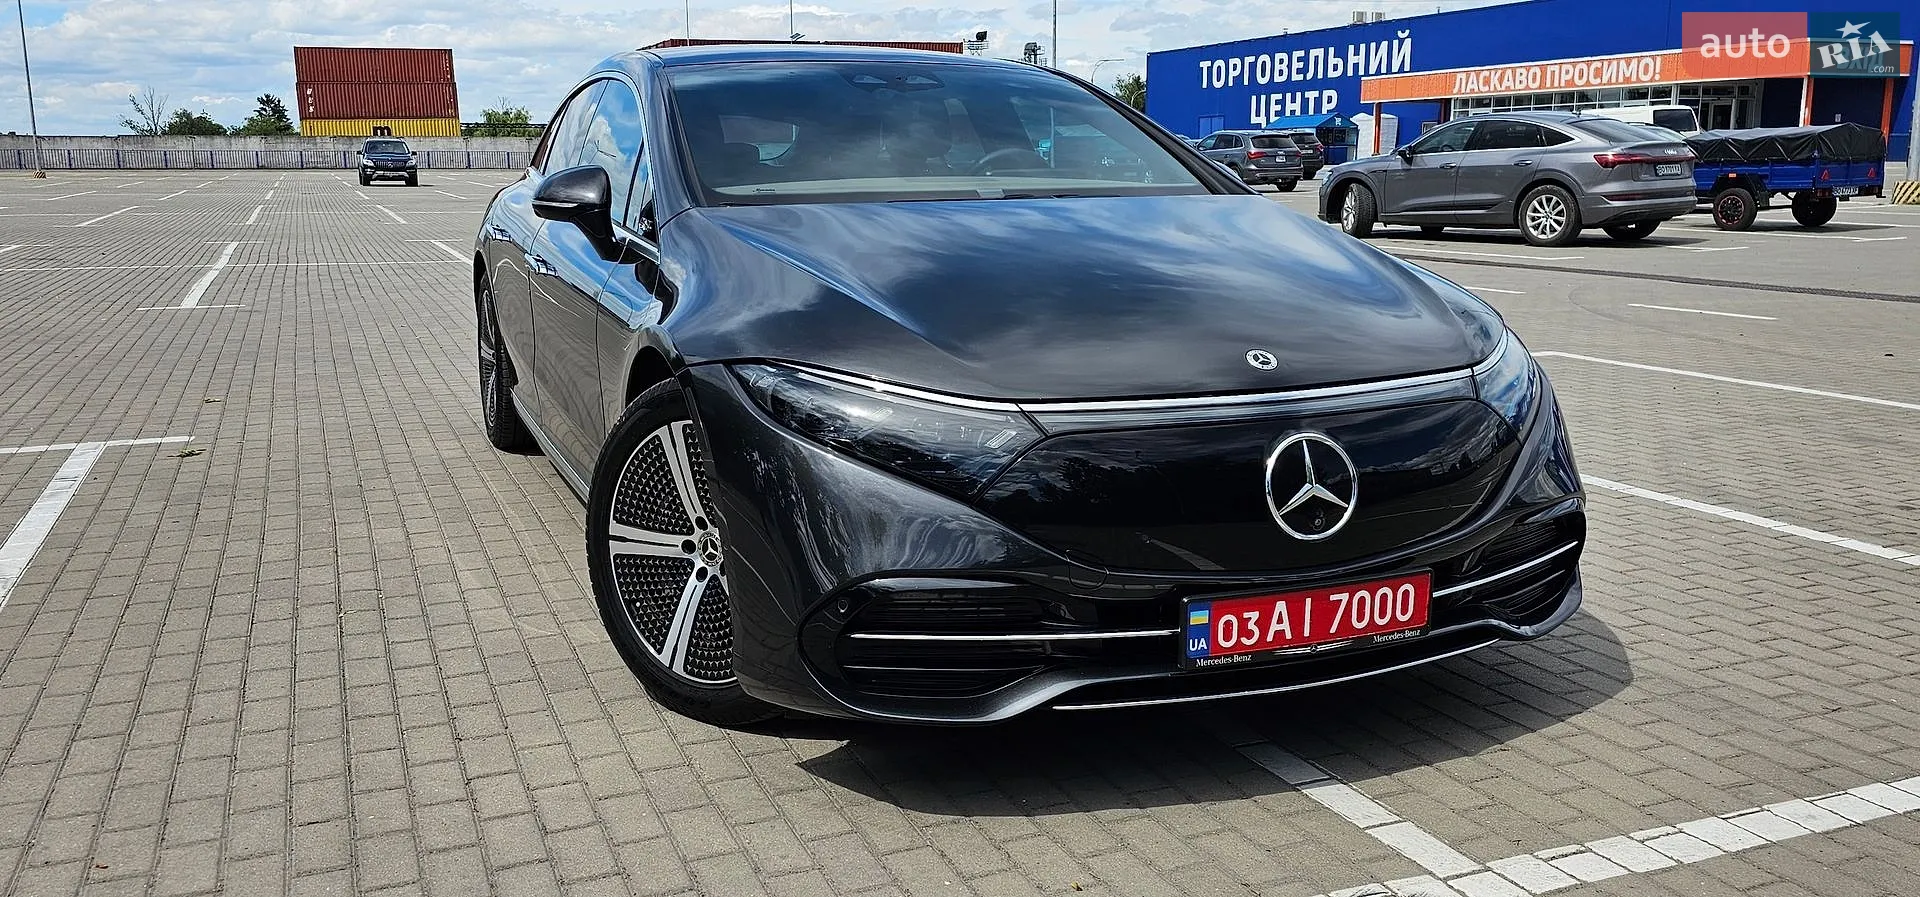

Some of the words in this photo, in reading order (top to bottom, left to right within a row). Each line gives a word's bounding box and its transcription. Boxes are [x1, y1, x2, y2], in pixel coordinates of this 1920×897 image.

[1199, 29, 1413, 89] ТОРГОВЕЛЬНИЙ
[1453, 65, 1541, 94] ЛАСКАВО
[1545, 56, 1662, 88] ПРОСИМО!
[1250, 89, 1338, 129] ЦЕНТР
[1329, 583, 1416, 634] 7000
[1189, 637, 1208, 652] UA
[1372, 629, 1421, 644] Mercedes-Benz
[1195, 654, 1252, 668] Mercedes-Benz
